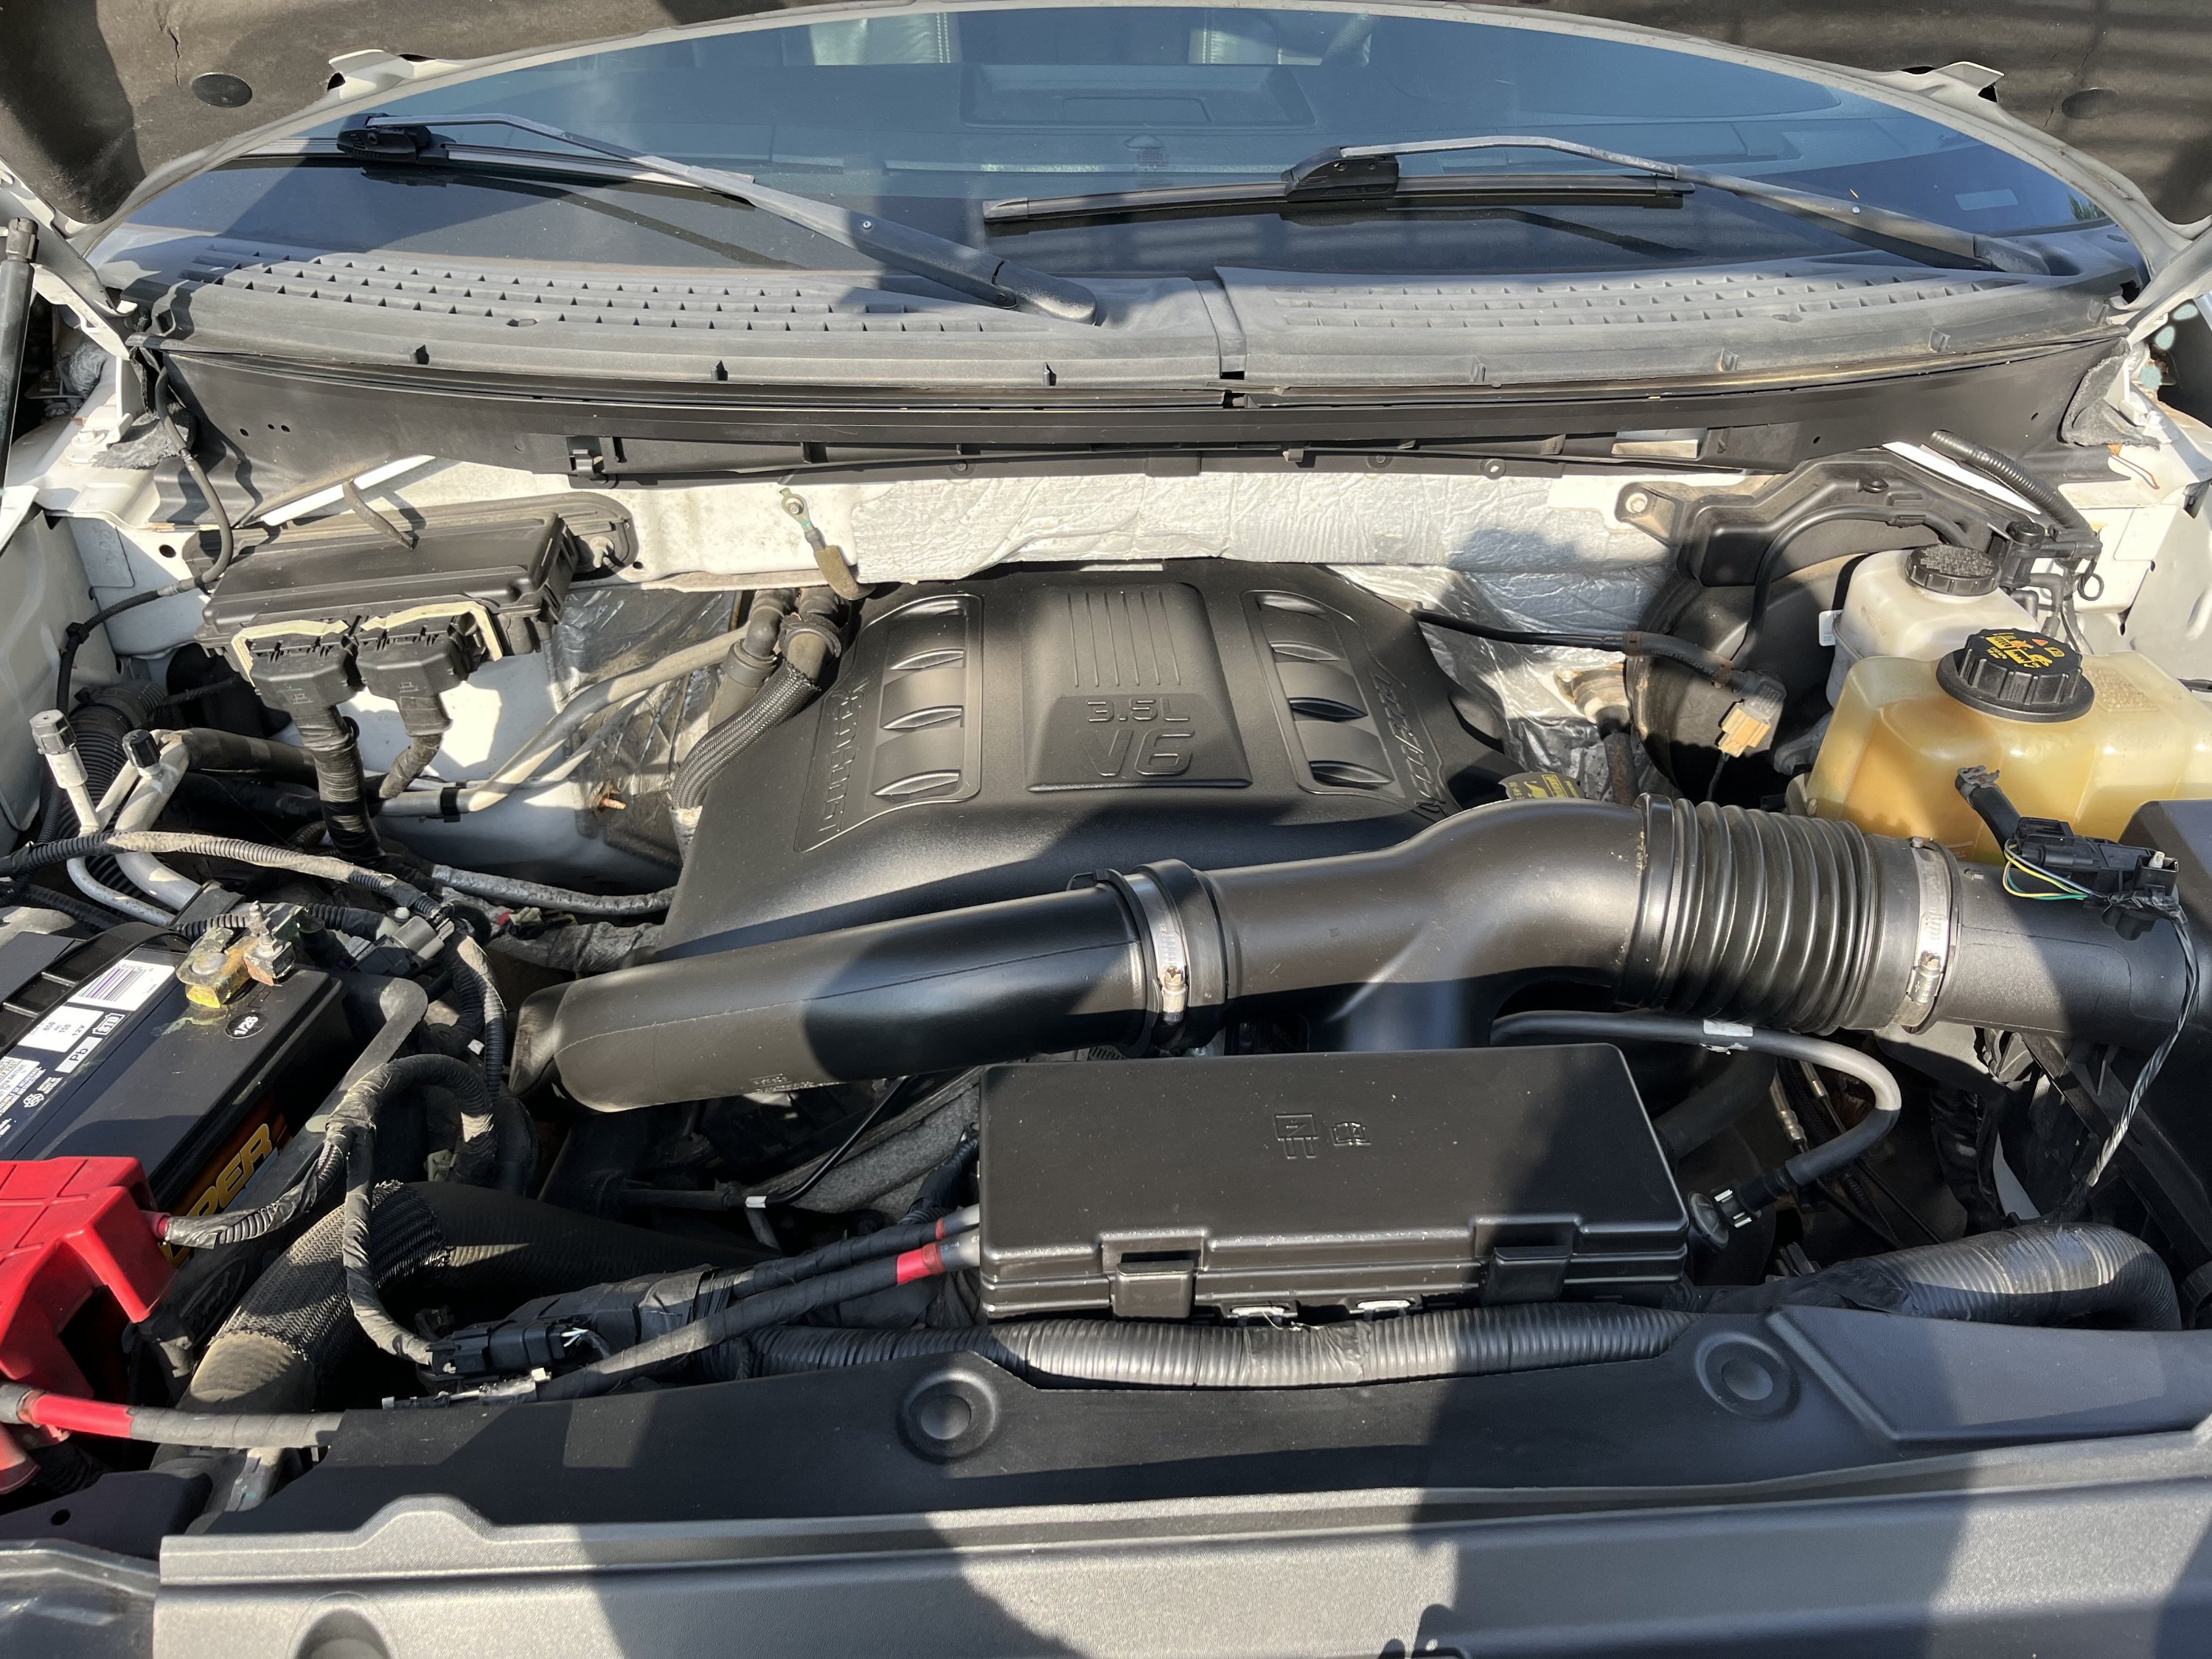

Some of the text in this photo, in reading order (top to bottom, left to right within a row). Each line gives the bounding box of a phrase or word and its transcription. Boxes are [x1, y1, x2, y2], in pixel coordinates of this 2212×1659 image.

[1086, 698, 1190, 723] 3.5L
[1076, 727, 1195, 776] V6
[234, 1016, 259, 1035] 1/26
[69, 1048, 88, 1061] Pb
